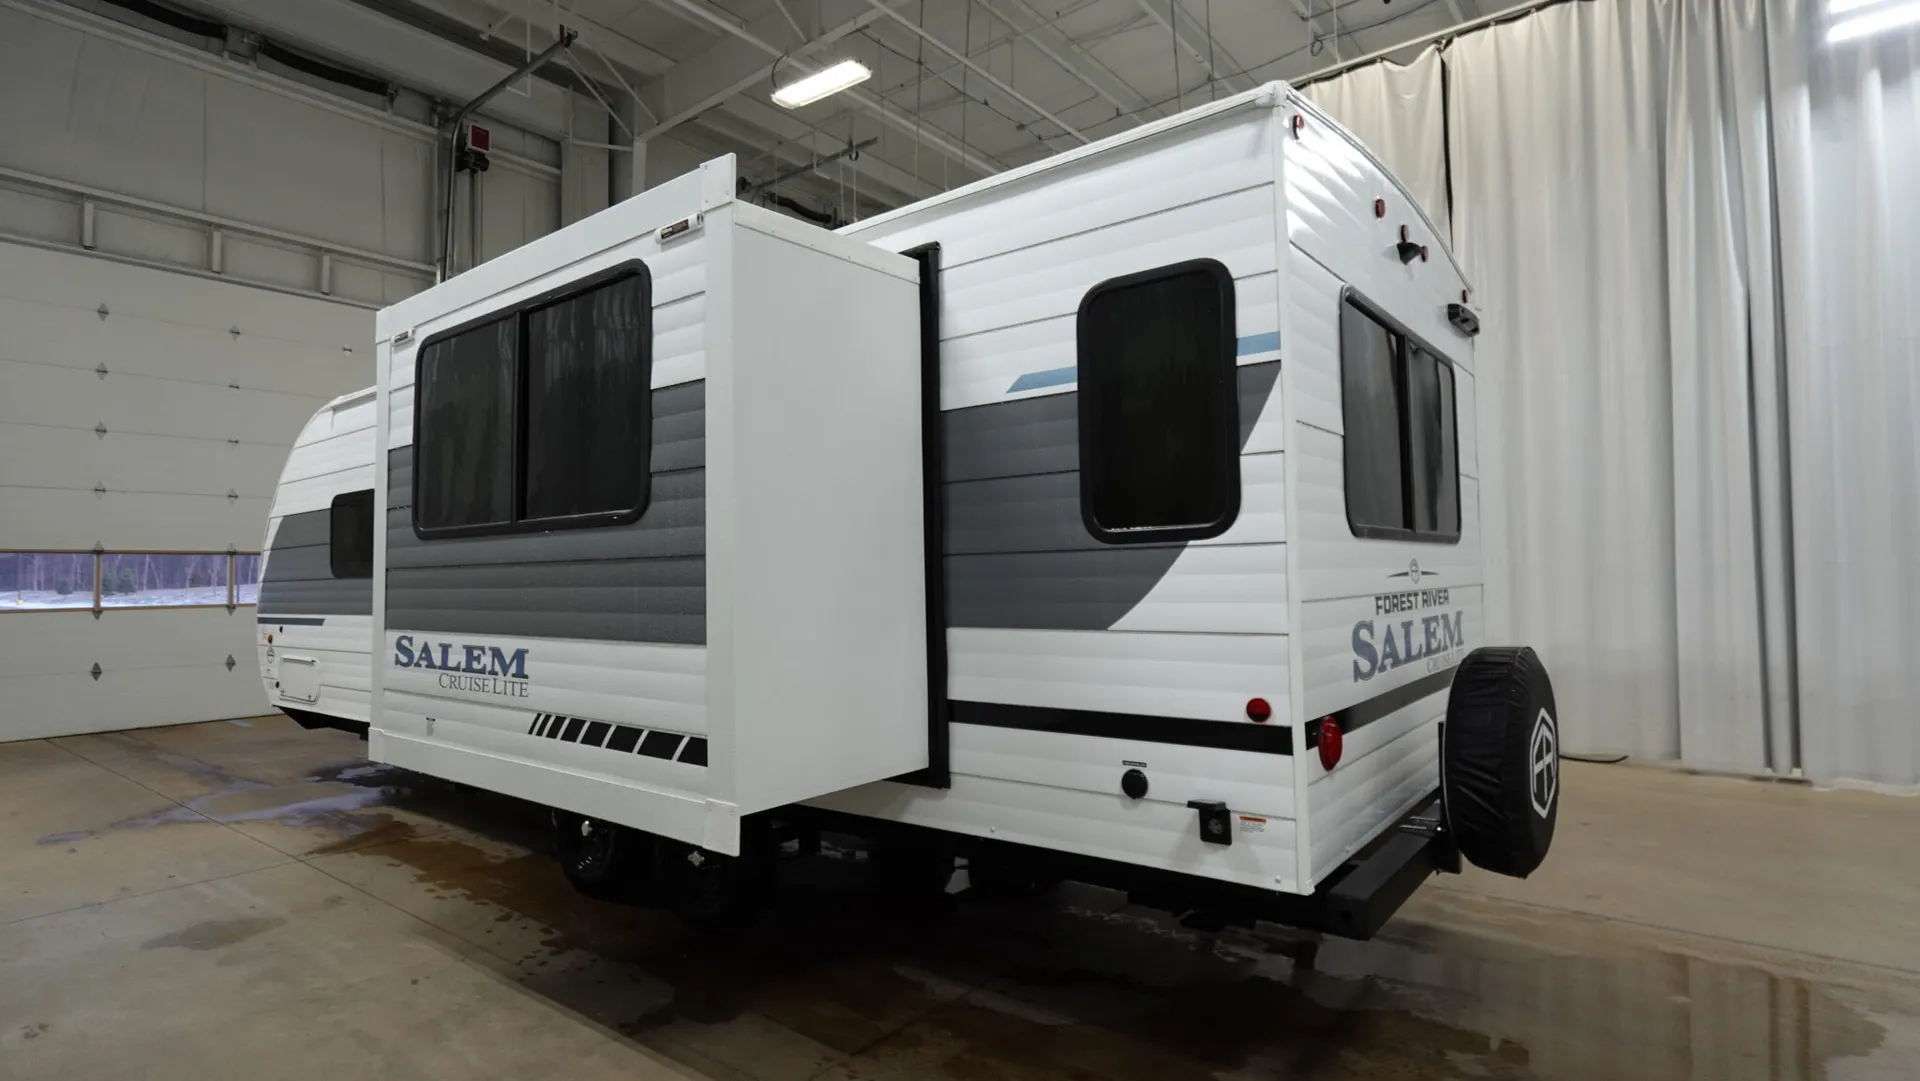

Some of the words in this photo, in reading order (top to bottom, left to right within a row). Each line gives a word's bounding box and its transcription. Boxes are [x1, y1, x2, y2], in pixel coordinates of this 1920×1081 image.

[1375, 592, 1420, 615] FOREST
[1421, 588, 1449, 608] RIVER
[395, 635, 529, 679] SALEM
[1351, 610, 1464, 683] SALEM
[438, 672, 529, 698] CRUISELITE
